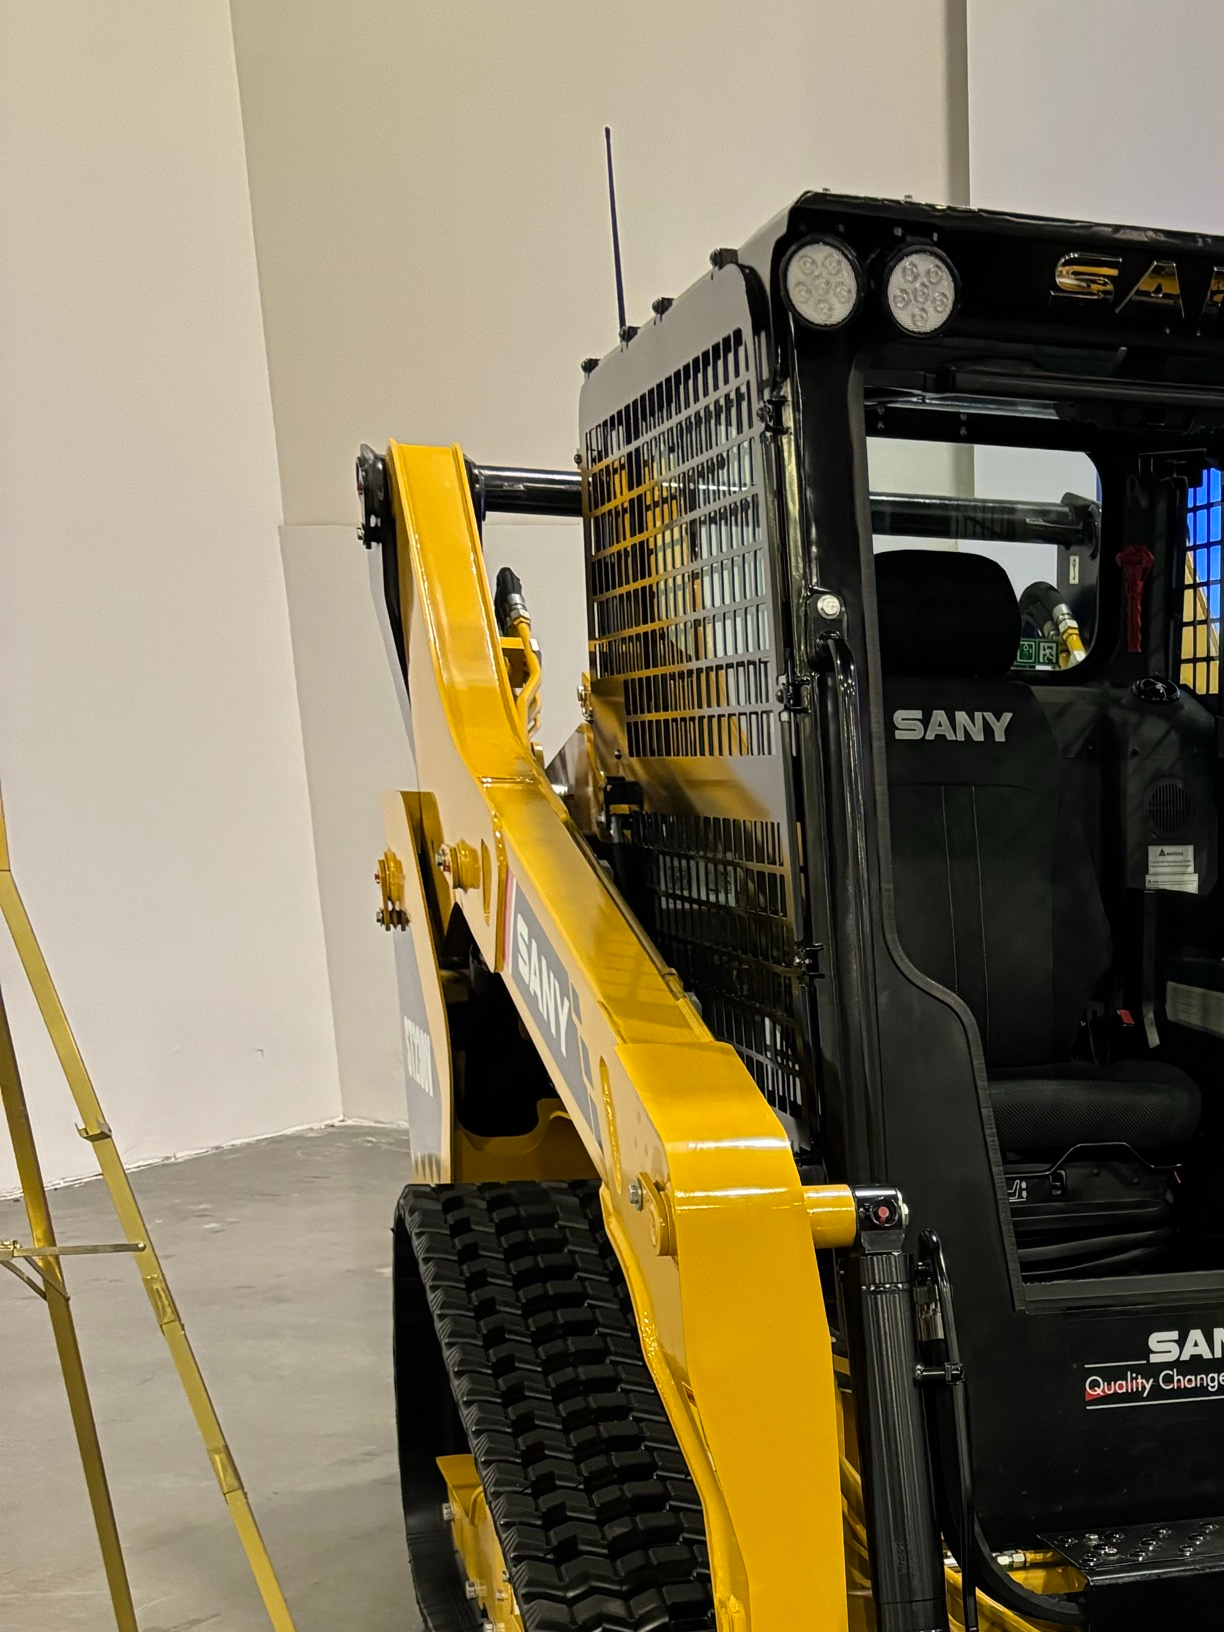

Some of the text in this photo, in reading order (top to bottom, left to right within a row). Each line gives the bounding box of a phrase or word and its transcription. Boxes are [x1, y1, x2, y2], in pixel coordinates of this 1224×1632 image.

[893, 709, 1013, 742] SANY
[517, 913, 570, 1059] SANY
[1085, 1370, 1153, 1398] Quality
